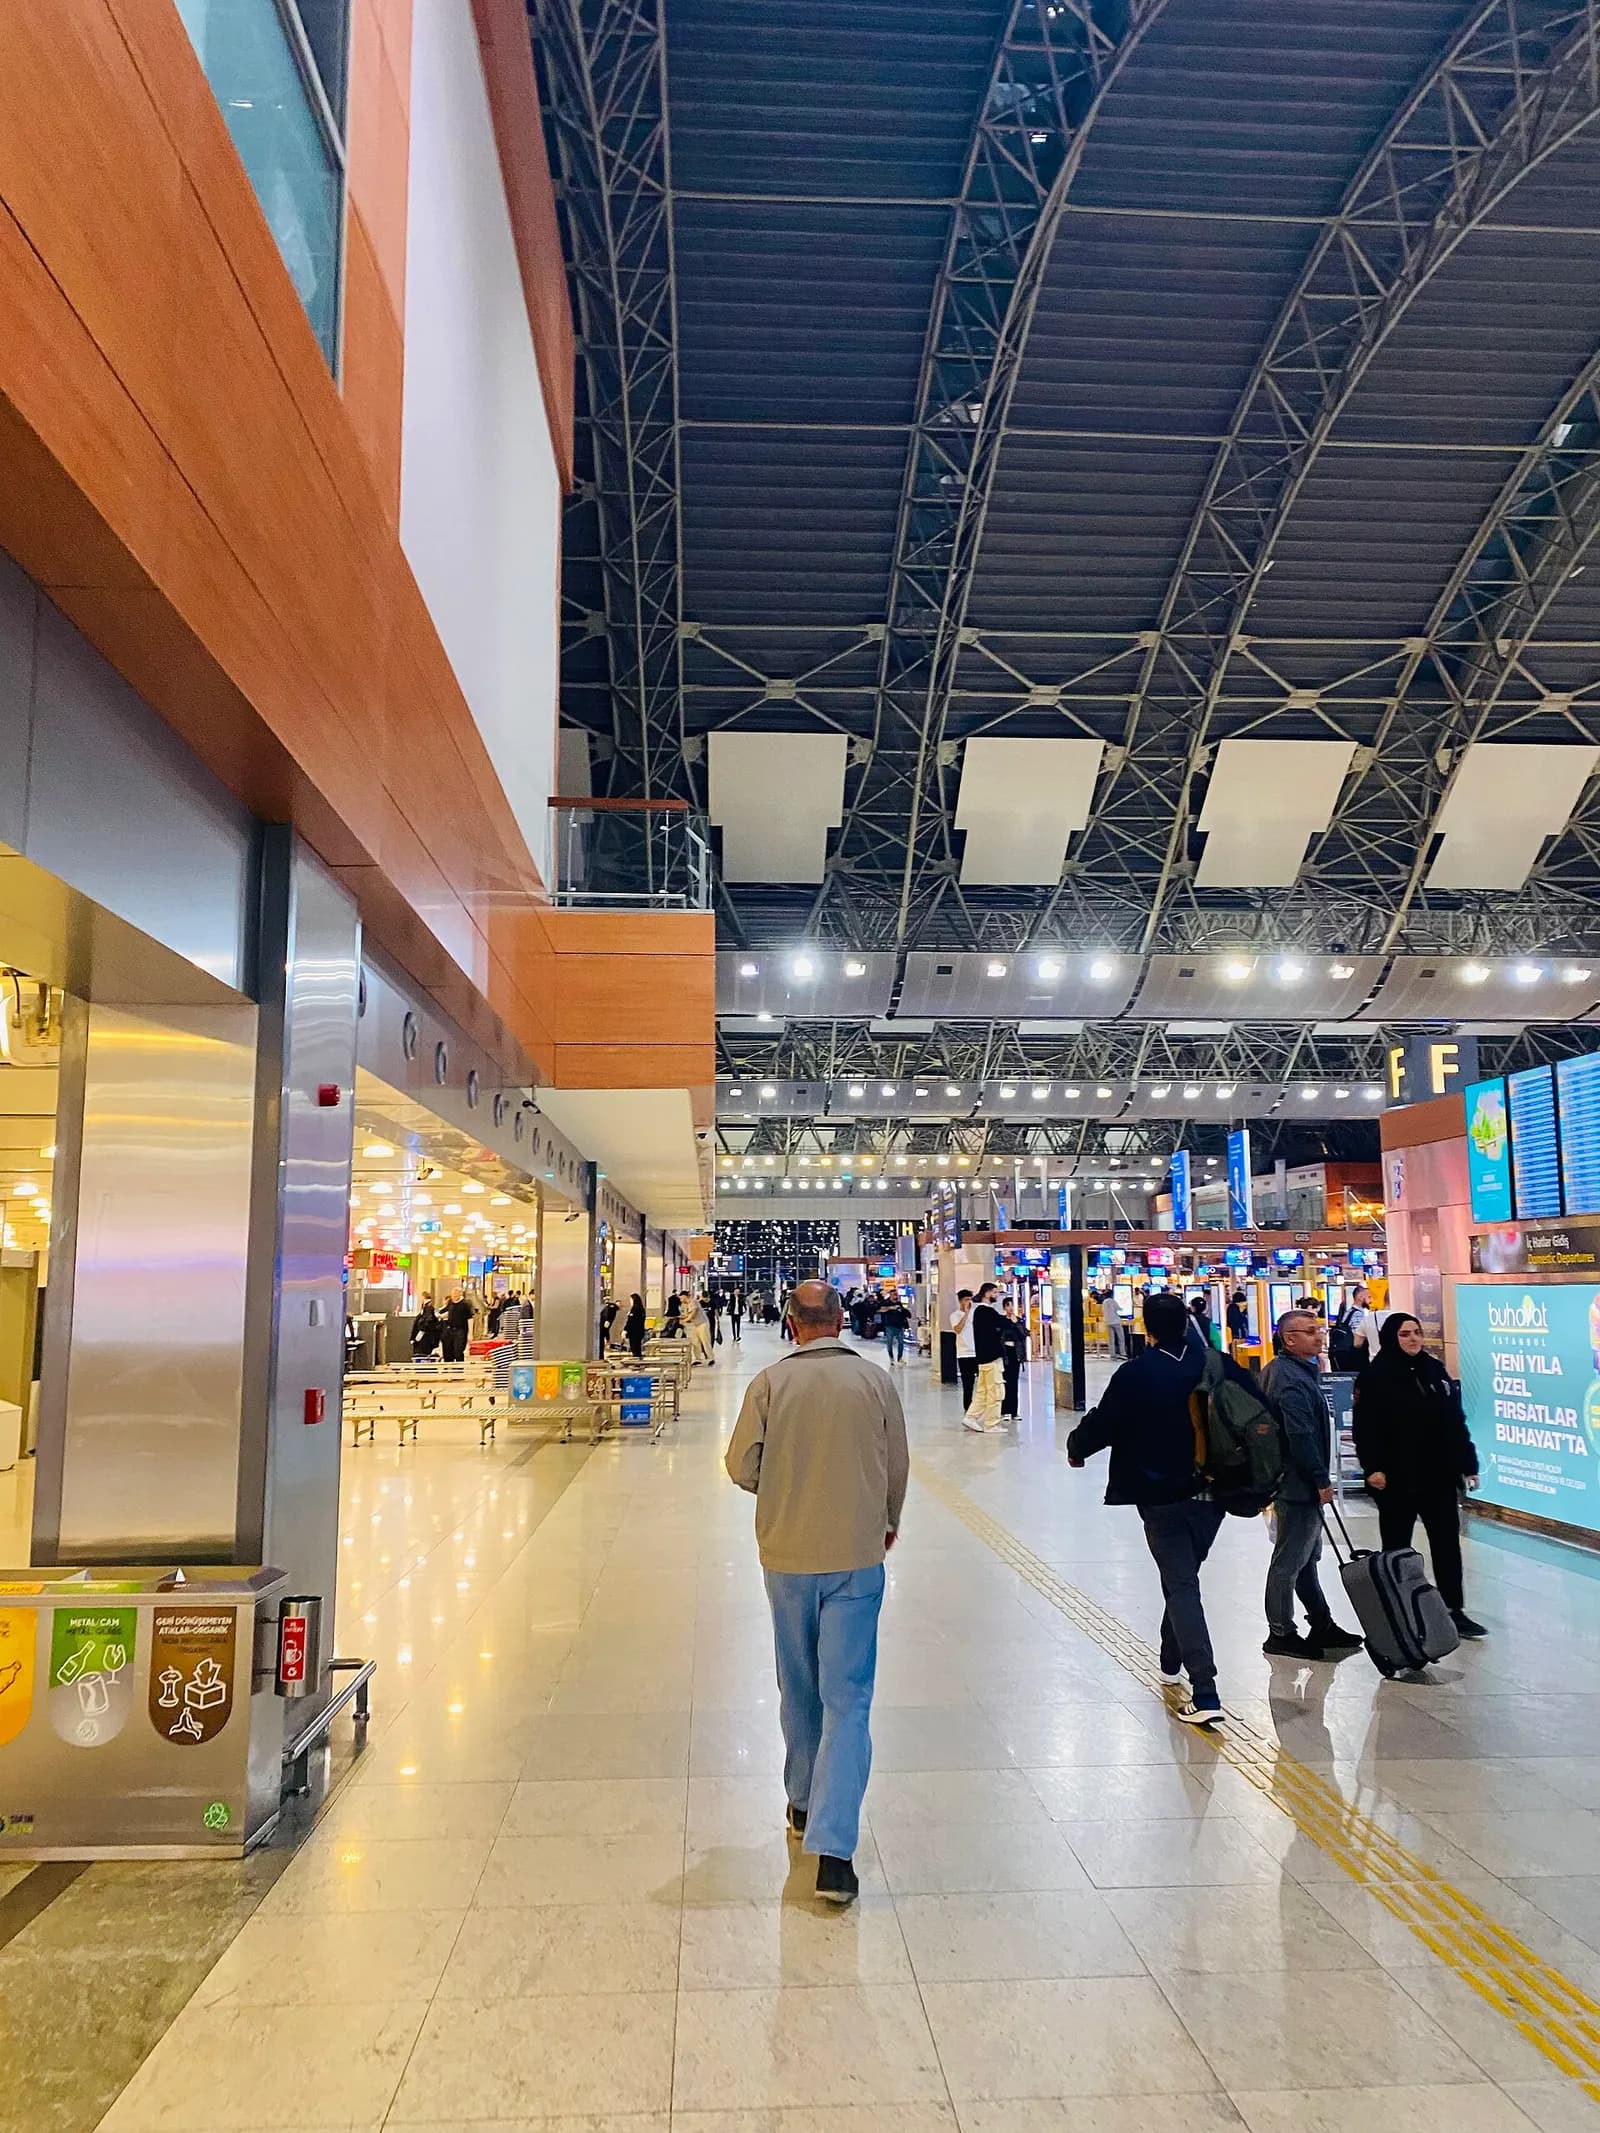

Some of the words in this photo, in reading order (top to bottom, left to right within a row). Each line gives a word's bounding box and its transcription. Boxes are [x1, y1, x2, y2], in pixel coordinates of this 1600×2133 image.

[1389, 1047, 1405, 1098] F
[1430, 1044, 1459, 1094] F
[902, 1222, 914, 1235] H
[1035, 1232, 1050, 1241] G01
[1114, 1232, 1130, 1241] G02
[1527, 1252, 1556, 1265] Domestic
[1557, 1252, 1595, 1265] Departures
[1487, 1299, 1549, 1328] buhayat
[1491, 1350, 1524, 1373] YENİ
[1525, 1354, 1563, 1376] YILA
[1492, 1373, 1532, 1398] ÖZEL
[1494, 1399, 1578, 1428] FIRSATLAR
[1496, 1423, 1588, 1457] BUHAYAT'TA
